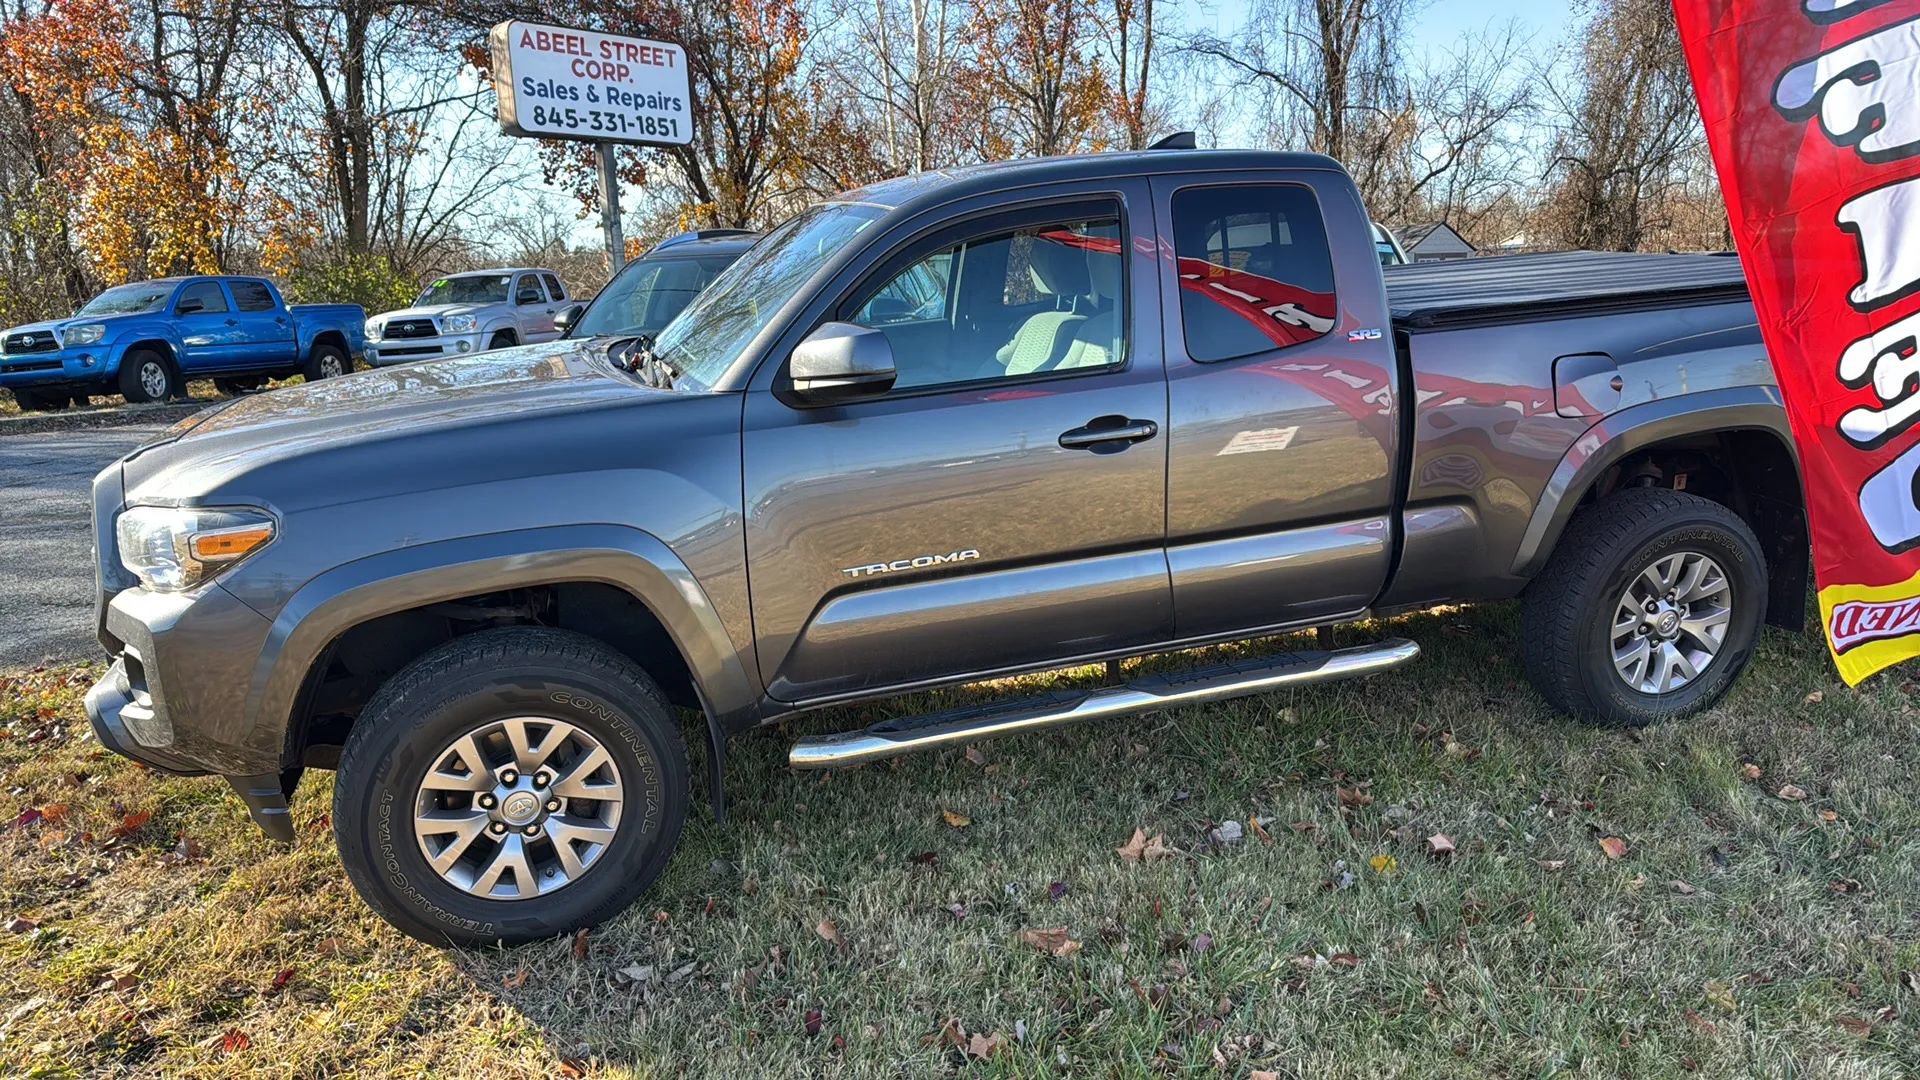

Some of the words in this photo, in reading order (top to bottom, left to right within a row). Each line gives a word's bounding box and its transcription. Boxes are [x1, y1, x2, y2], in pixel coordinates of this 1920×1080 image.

[520, 29, 592, 57] ABEEL
[600, 40, 676, 68] STREET
[571, 58, 634, 83] CORP.
[521, 76, 580, 102] Sales
[586, 84, 601, 104] &
[606, 87, 681, 111] Repairs
[533, 105, 679, 138] 845-331-1851
[1348, 328, 1382, 342] SR5
[842, 549, 980, 577] TACOMA
[1630, 528, 1745, 573] CONTINENTAL
[549, 690, 660, 834] CONTINENTAL
